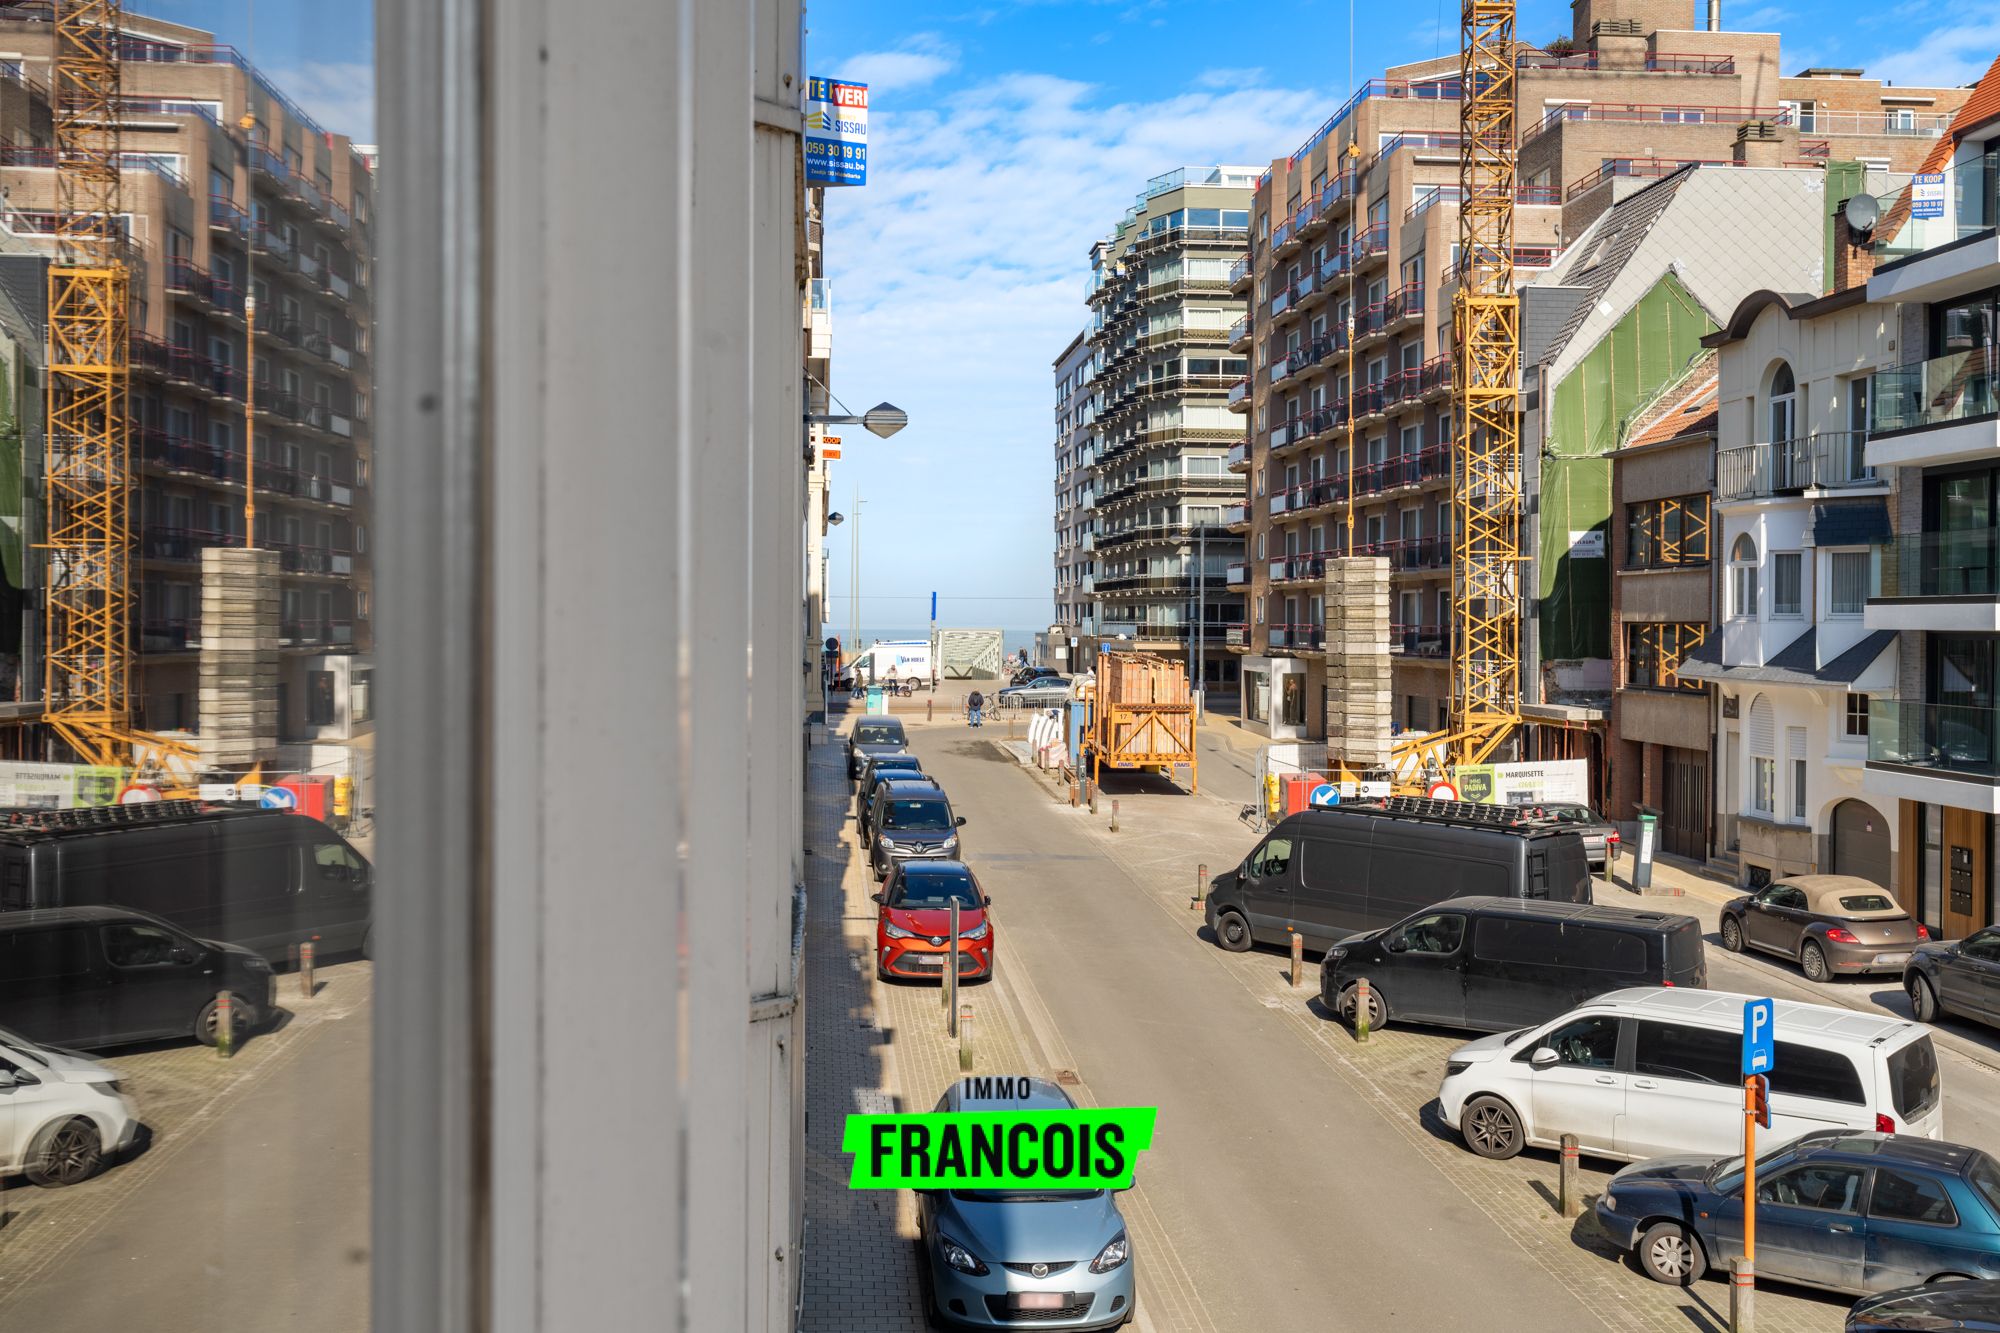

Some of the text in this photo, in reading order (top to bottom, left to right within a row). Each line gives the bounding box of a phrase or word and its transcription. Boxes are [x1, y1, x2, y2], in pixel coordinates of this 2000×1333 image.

[810, 80, 825, 99] TE
[835, 120, 866, 135] SISSAU
[807, 142, 866, 160] 059 30 19 91
[807, 158, 865, 171] www.sissau.be
[1915, 175, 1943, 184] TE KOOP
[1505, 770, 1544, 778] MARQUISETTE
[1464, 784, 1487, 792] PADIVA
[1752, 1005, 1768, 1044] P
